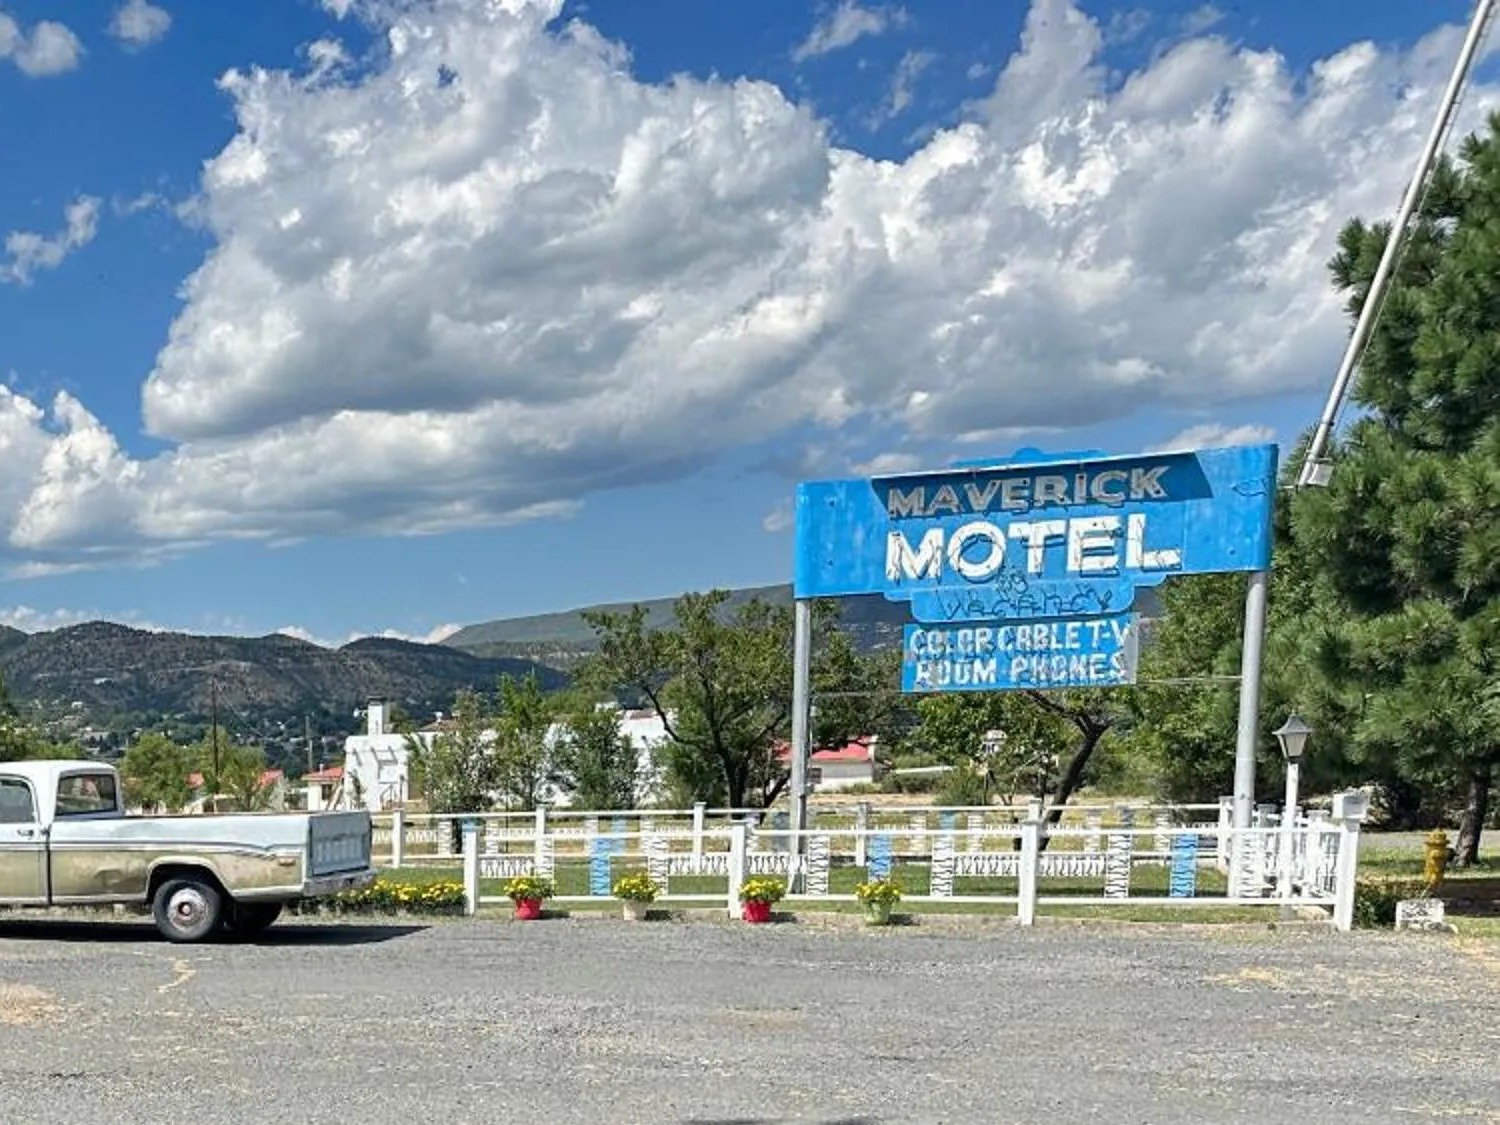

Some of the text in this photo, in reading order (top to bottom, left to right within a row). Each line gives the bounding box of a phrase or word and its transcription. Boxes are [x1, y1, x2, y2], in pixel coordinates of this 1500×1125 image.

[888, 466, 1170, 519] MAVERICK
[885, 513, 1182, 582] MOTEL
[910, 626, 994, 655] COLOR
[997, 621, 1081, 652] CABLE
[916, 652, 1127, 687] ROOM PHONES
